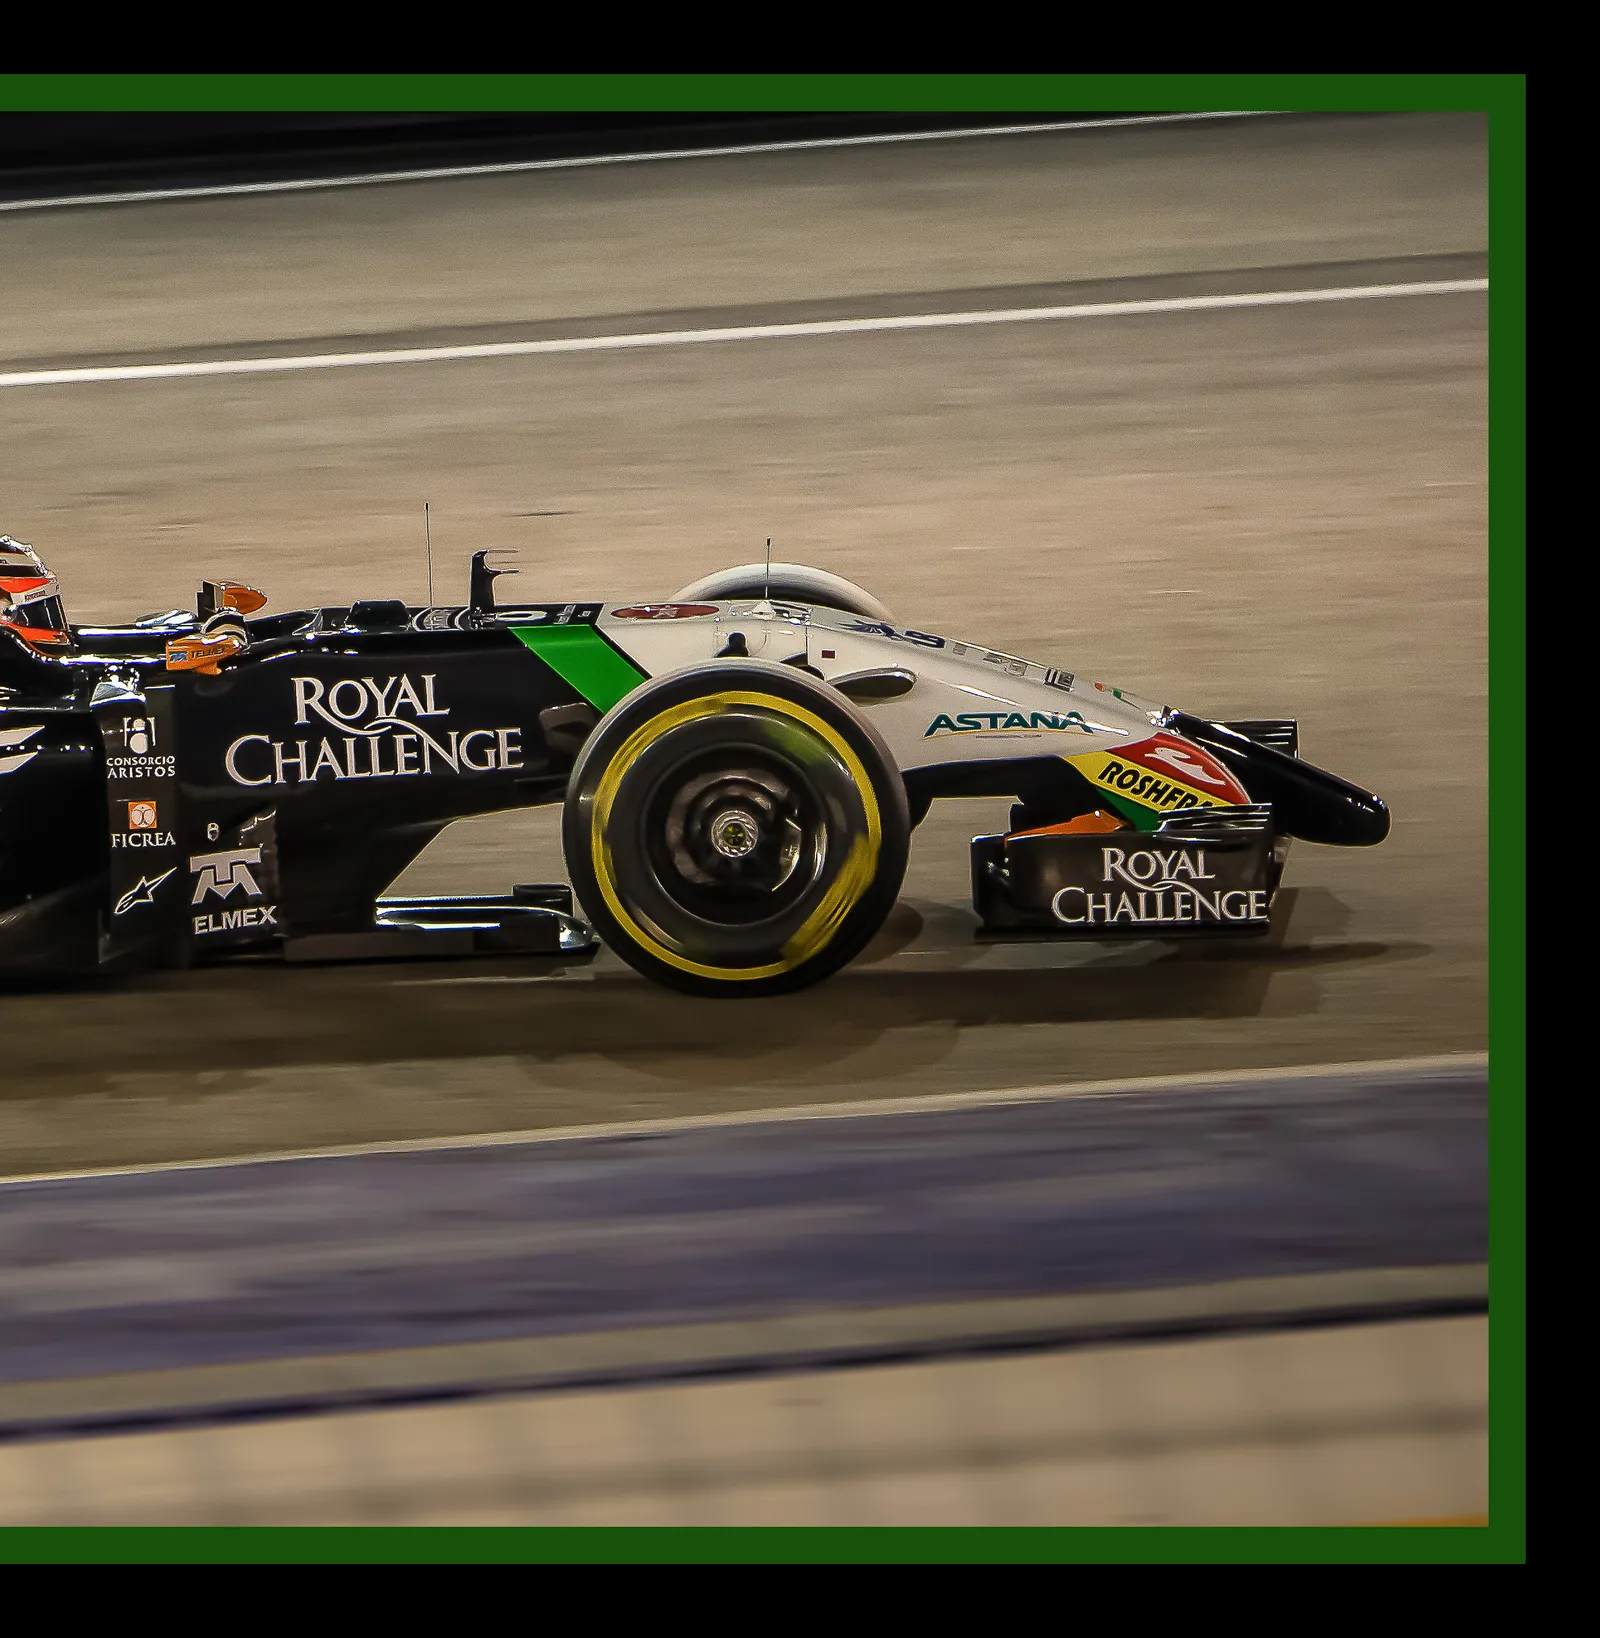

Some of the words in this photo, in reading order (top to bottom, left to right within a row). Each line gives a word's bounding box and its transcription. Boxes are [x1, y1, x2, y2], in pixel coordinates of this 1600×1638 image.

[291, 674, 450, 736] ROYAL
[924, 711, 1093, 737] ASTANA
[106, 755, 176, 767] CONSORCIO
[225, 719, 524, 785] CHALLENGE
[107, 765, 176, 779] ARISTOS
[111, 832, 176, 848] FICREA
[1102, 848, 1215, 891] ROYAL
[1052, 881, 1269, 923] CHALLENGE
